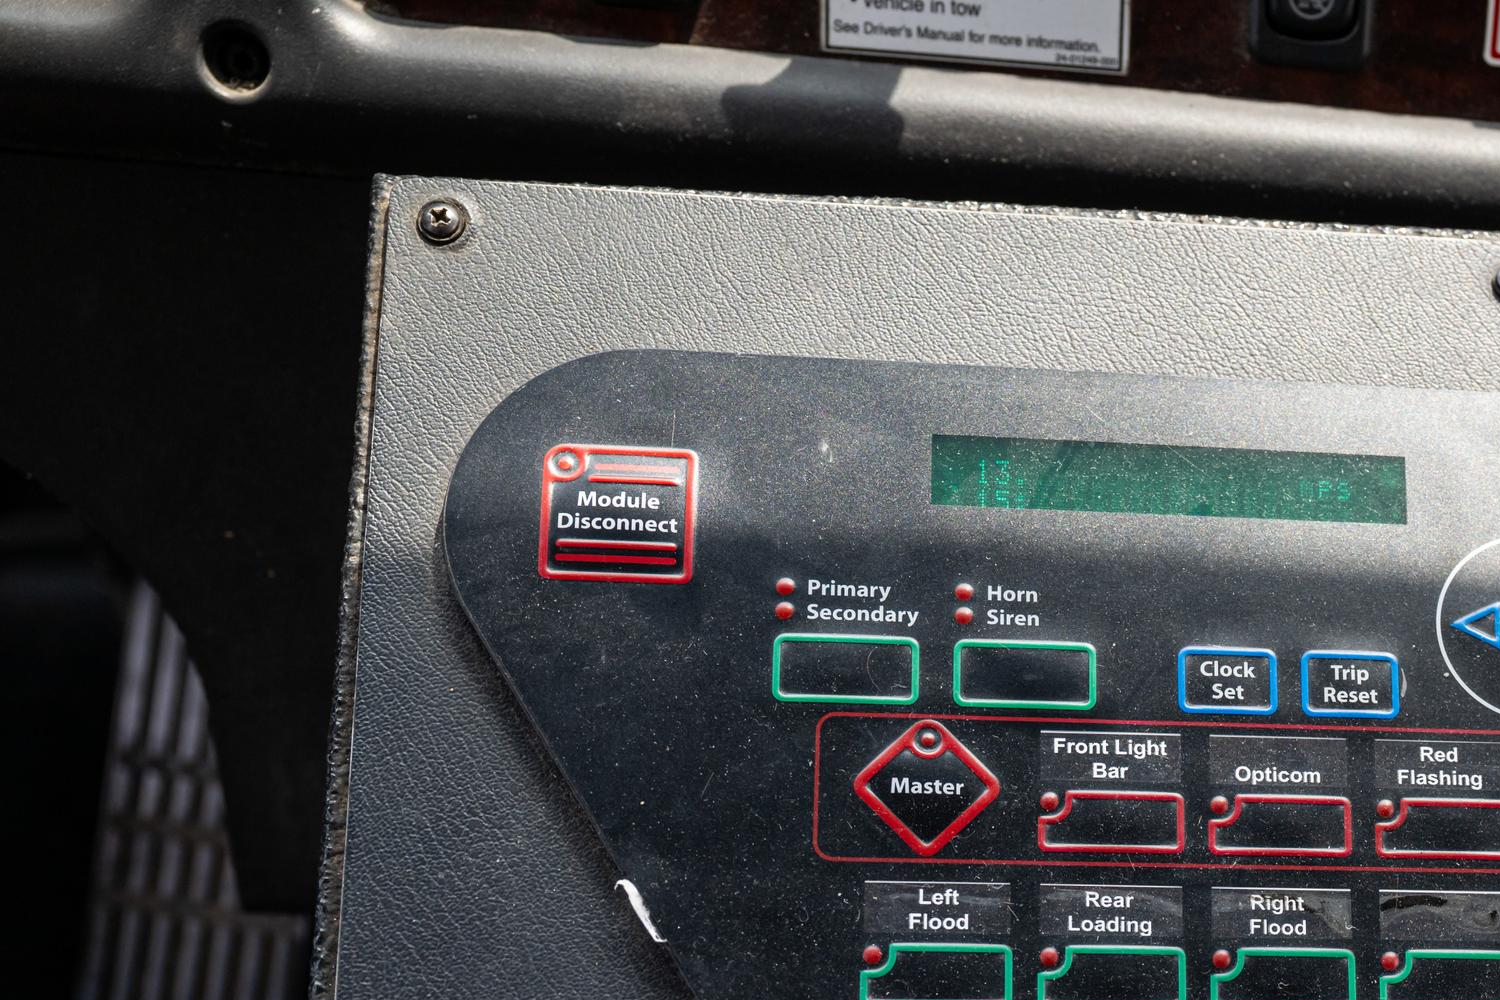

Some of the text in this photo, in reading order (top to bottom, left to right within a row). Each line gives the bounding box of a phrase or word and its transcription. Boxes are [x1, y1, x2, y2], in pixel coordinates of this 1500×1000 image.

[864, 0, 981, 16] vehicle in tow
[834, 19, 1101, 53] See Driver's Manual for more information.
[577, 491, 660, 509] Module
[557, 512, 678, 533] Disconnect
[807, 579, 891, 602] Primary
[987, 585, 1038, 602] Horn
[806, 604, 919, 627] Secondary
[986, 609, 1040, 626] Siren
[1200, 660, 1255, 678] Clock
[1330, 665, 1370, 684] Trip
[1212, 684, 1244, 700] Set
[1323, 687, 1378, 704] Reset
[1053, 738, 1167, 760] Front Light
[1420, 746, 1458, 763] Red
[1092, 763, 1128, 779] Bar
[1235, 766, 1321, 785] Opticom
[1398, 769, 1483, 790] Flashing
[890, 777, 964, 796] Master
[918, 889, 960, 905] Left
[1085, 891, 1134, 908] Rear
[1250, 895, 1305, 915] Right
[908, 912, 969, 930] Flood
[1067, 916, 1153, 937] Loading
[1249, 918, 1307, 936] Flood
